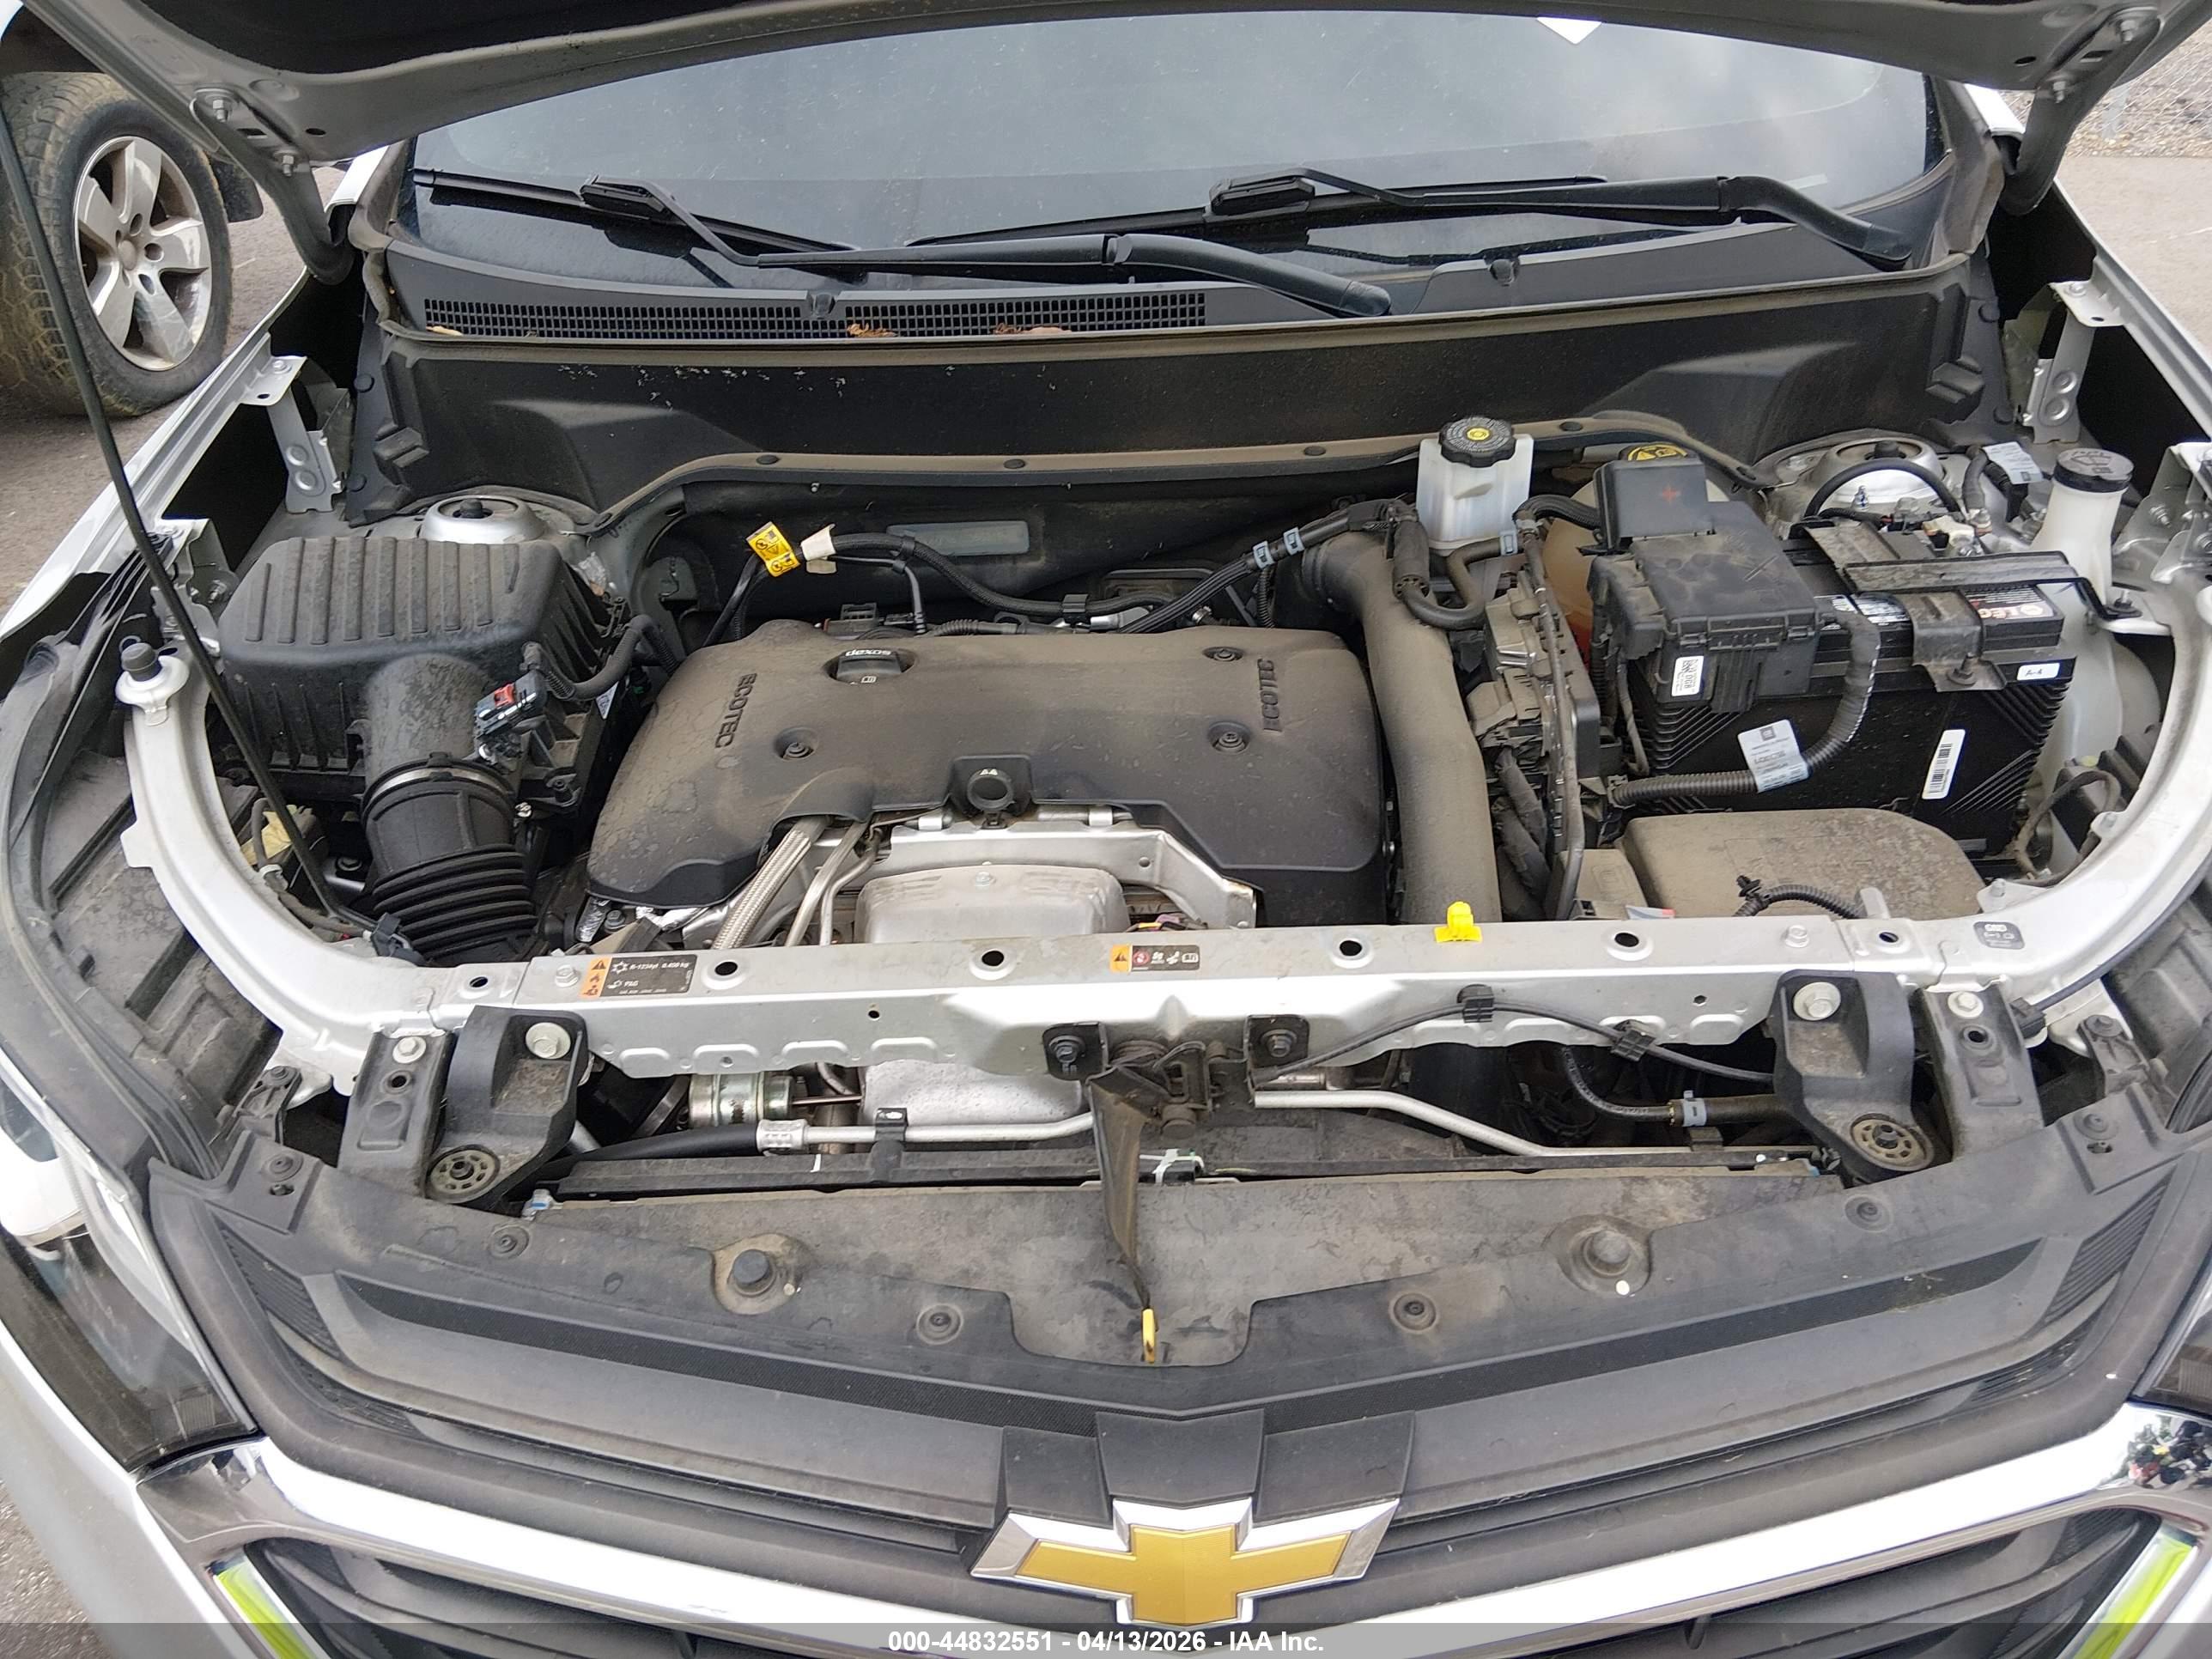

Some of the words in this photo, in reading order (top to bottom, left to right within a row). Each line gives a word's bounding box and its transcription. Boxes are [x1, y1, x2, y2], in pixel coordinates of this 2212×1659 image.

[845, 648, 892, 657] dexos
[714, 672, 757, 749] ECOTEC
[1257, 659, 1283, 732] ECOTEC
